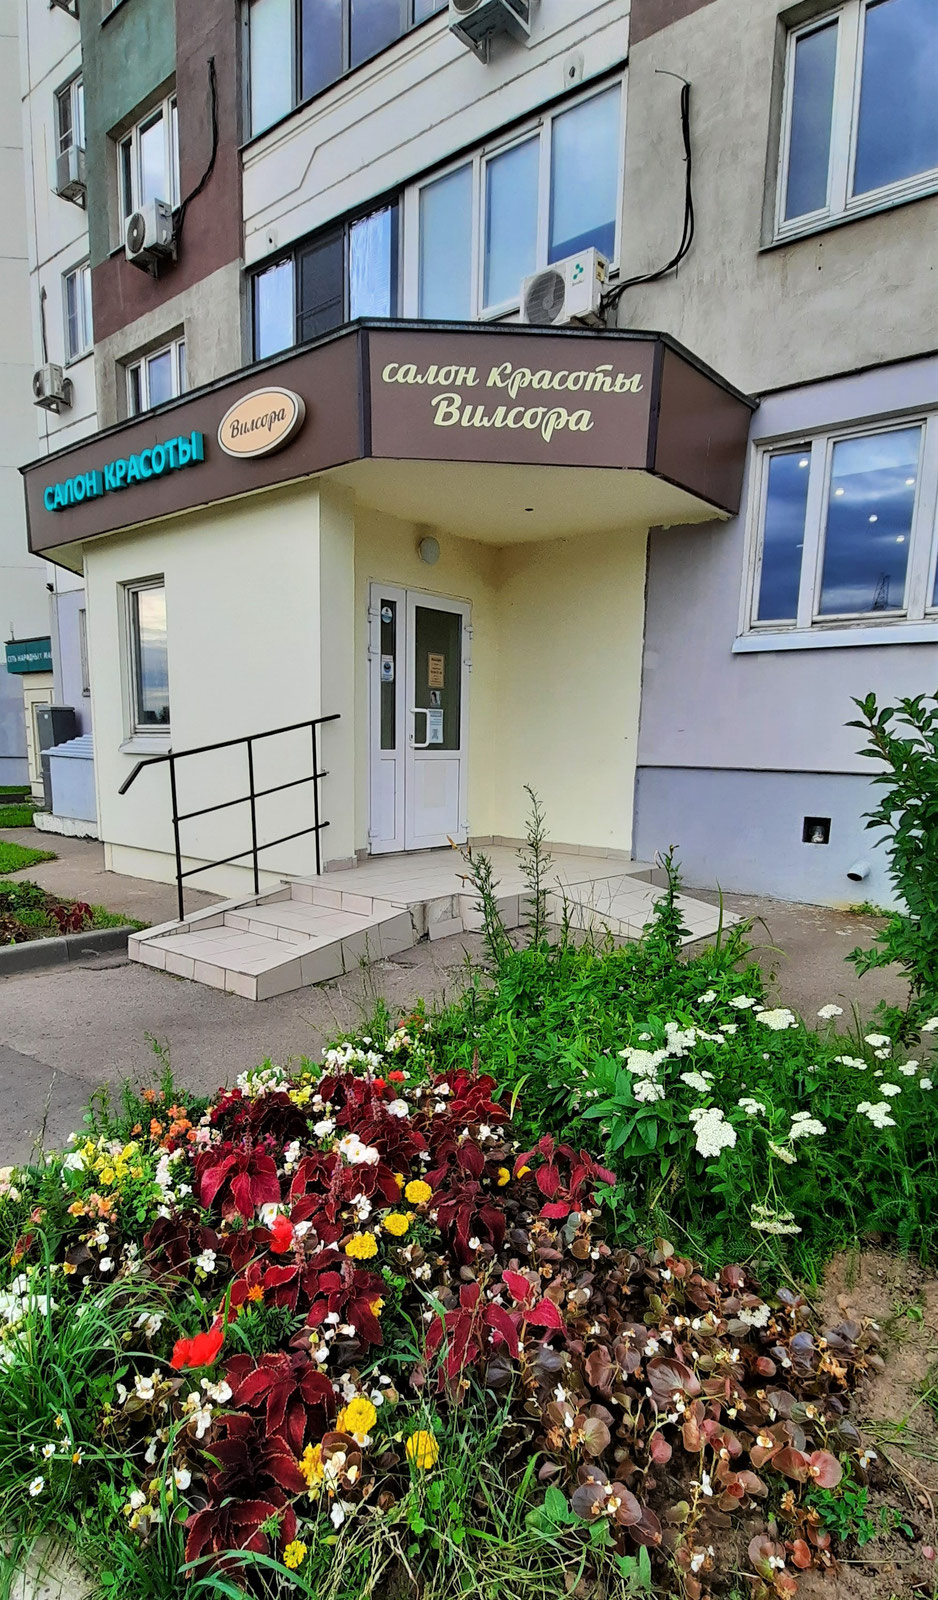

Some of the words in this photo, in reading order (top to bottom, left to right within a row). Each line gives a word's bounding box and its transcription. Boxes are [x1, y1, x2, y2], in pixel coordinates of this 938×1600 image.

[382, 363, 480, 386] салон
[486, 362, 644, 399] красоты
[230, 407, 287, 438] Вилсора
[430, 392, 595, 443] Вилсора
[44, 470, 103, 512] САЛОН
[104, 431, 204, 491] КРАСОТЫ
